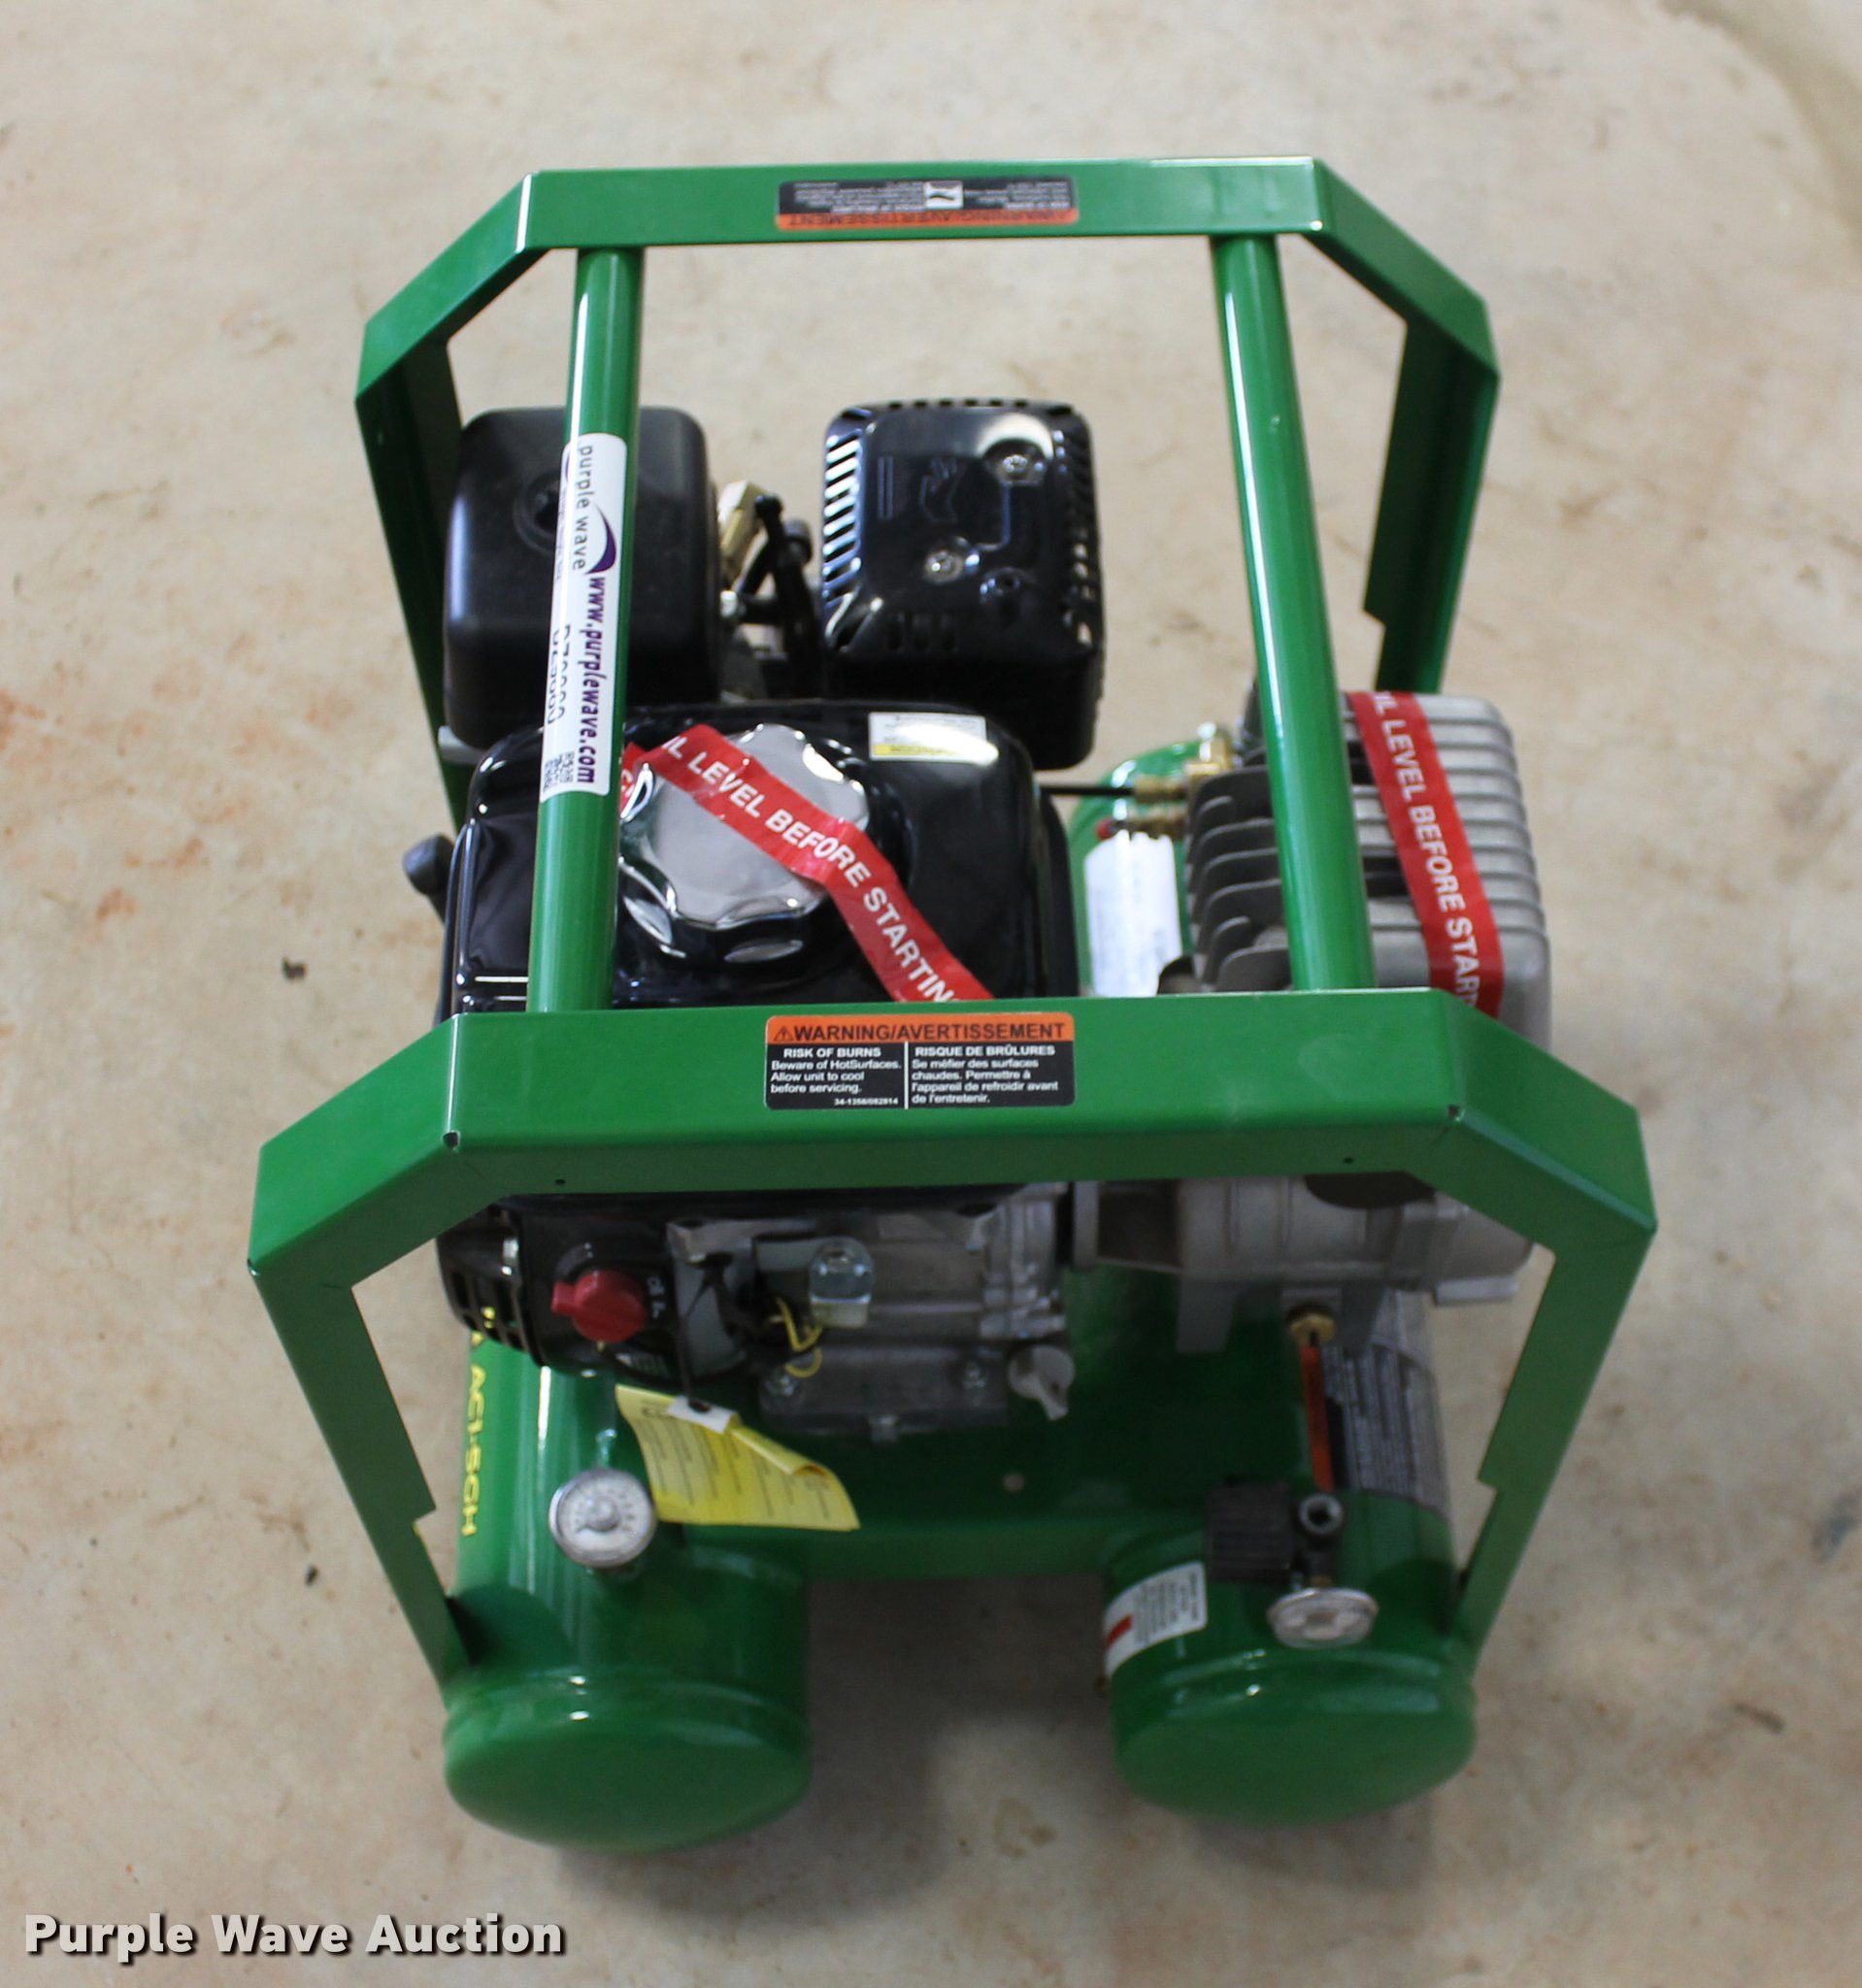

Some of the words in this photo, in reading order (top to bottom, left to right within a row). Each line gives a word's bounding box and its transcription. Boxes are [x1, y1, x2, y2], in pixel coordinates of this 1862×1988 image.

[574, 445, 595, 509] purple
[573, 515, 590, 570] wave
[575, 576, 609, 783] www.purplewave.com
[1373, 691, 1398, 716] IL
[1380, 719, 1427, 801] LEVEL
[1409, 804, 1467, 912] BEFORE
[661, 735, 688, 759] IL
[686, 750, 767, 819] LEVEL
[764, 808, 872, 888] BEFORE
[862, 885, 957, 1002] STARTIN
[1446, 915, 1481, 1007] START
[793, 1022, 1066, 1042] WARNING/AVERTISSEMENT
[782, 1047, 814, 1058] RISK
[815, 1047, 834, 1058] OF
[836, 1046, 882, 1058] BURNS
[914, 1045, 964, 1057] RISQUE
[965, 1045, 984, 1056] DE
[985, 1044, 1056, 1056] BRÛLURES
[771, 1060, 815, 1071] Beware
[815, 1060, 828, 1070] of
[829, 1060, 902, 1070] HotSurfaces.
[911, 1059, 927, 1069] Se
[929, 1059, 966, 1069] méfier
[967, 1058, 989, 1069] des
[990, 1058, 1040, 1069] surfaces
[770, 1072, 801, 1082] Allow
[803, 1072, 825, 1081] unit
[826, 1072, 839, 1081] to
[840, 1071, 865, 1081] cool
[911, 1070, 962, 1080] chaudes.
[964, 1070, 1021, 1080] Permettre
[1022, 1070, 1032, 1079] à
[770, 1083, 807, 1093] before
[809, 1082, 862, 1095] servicing.
[911, 1081, 963, 1093] l'appareil
[964, 1081, 980, 1092] de
[981, 1081, 1025, 1092] refroidir
[1026, 1080, 1059, 1091] avant
[911, 1093, 927, 1104] de
[928, 1093, 990, 1104] l'entretenir.
